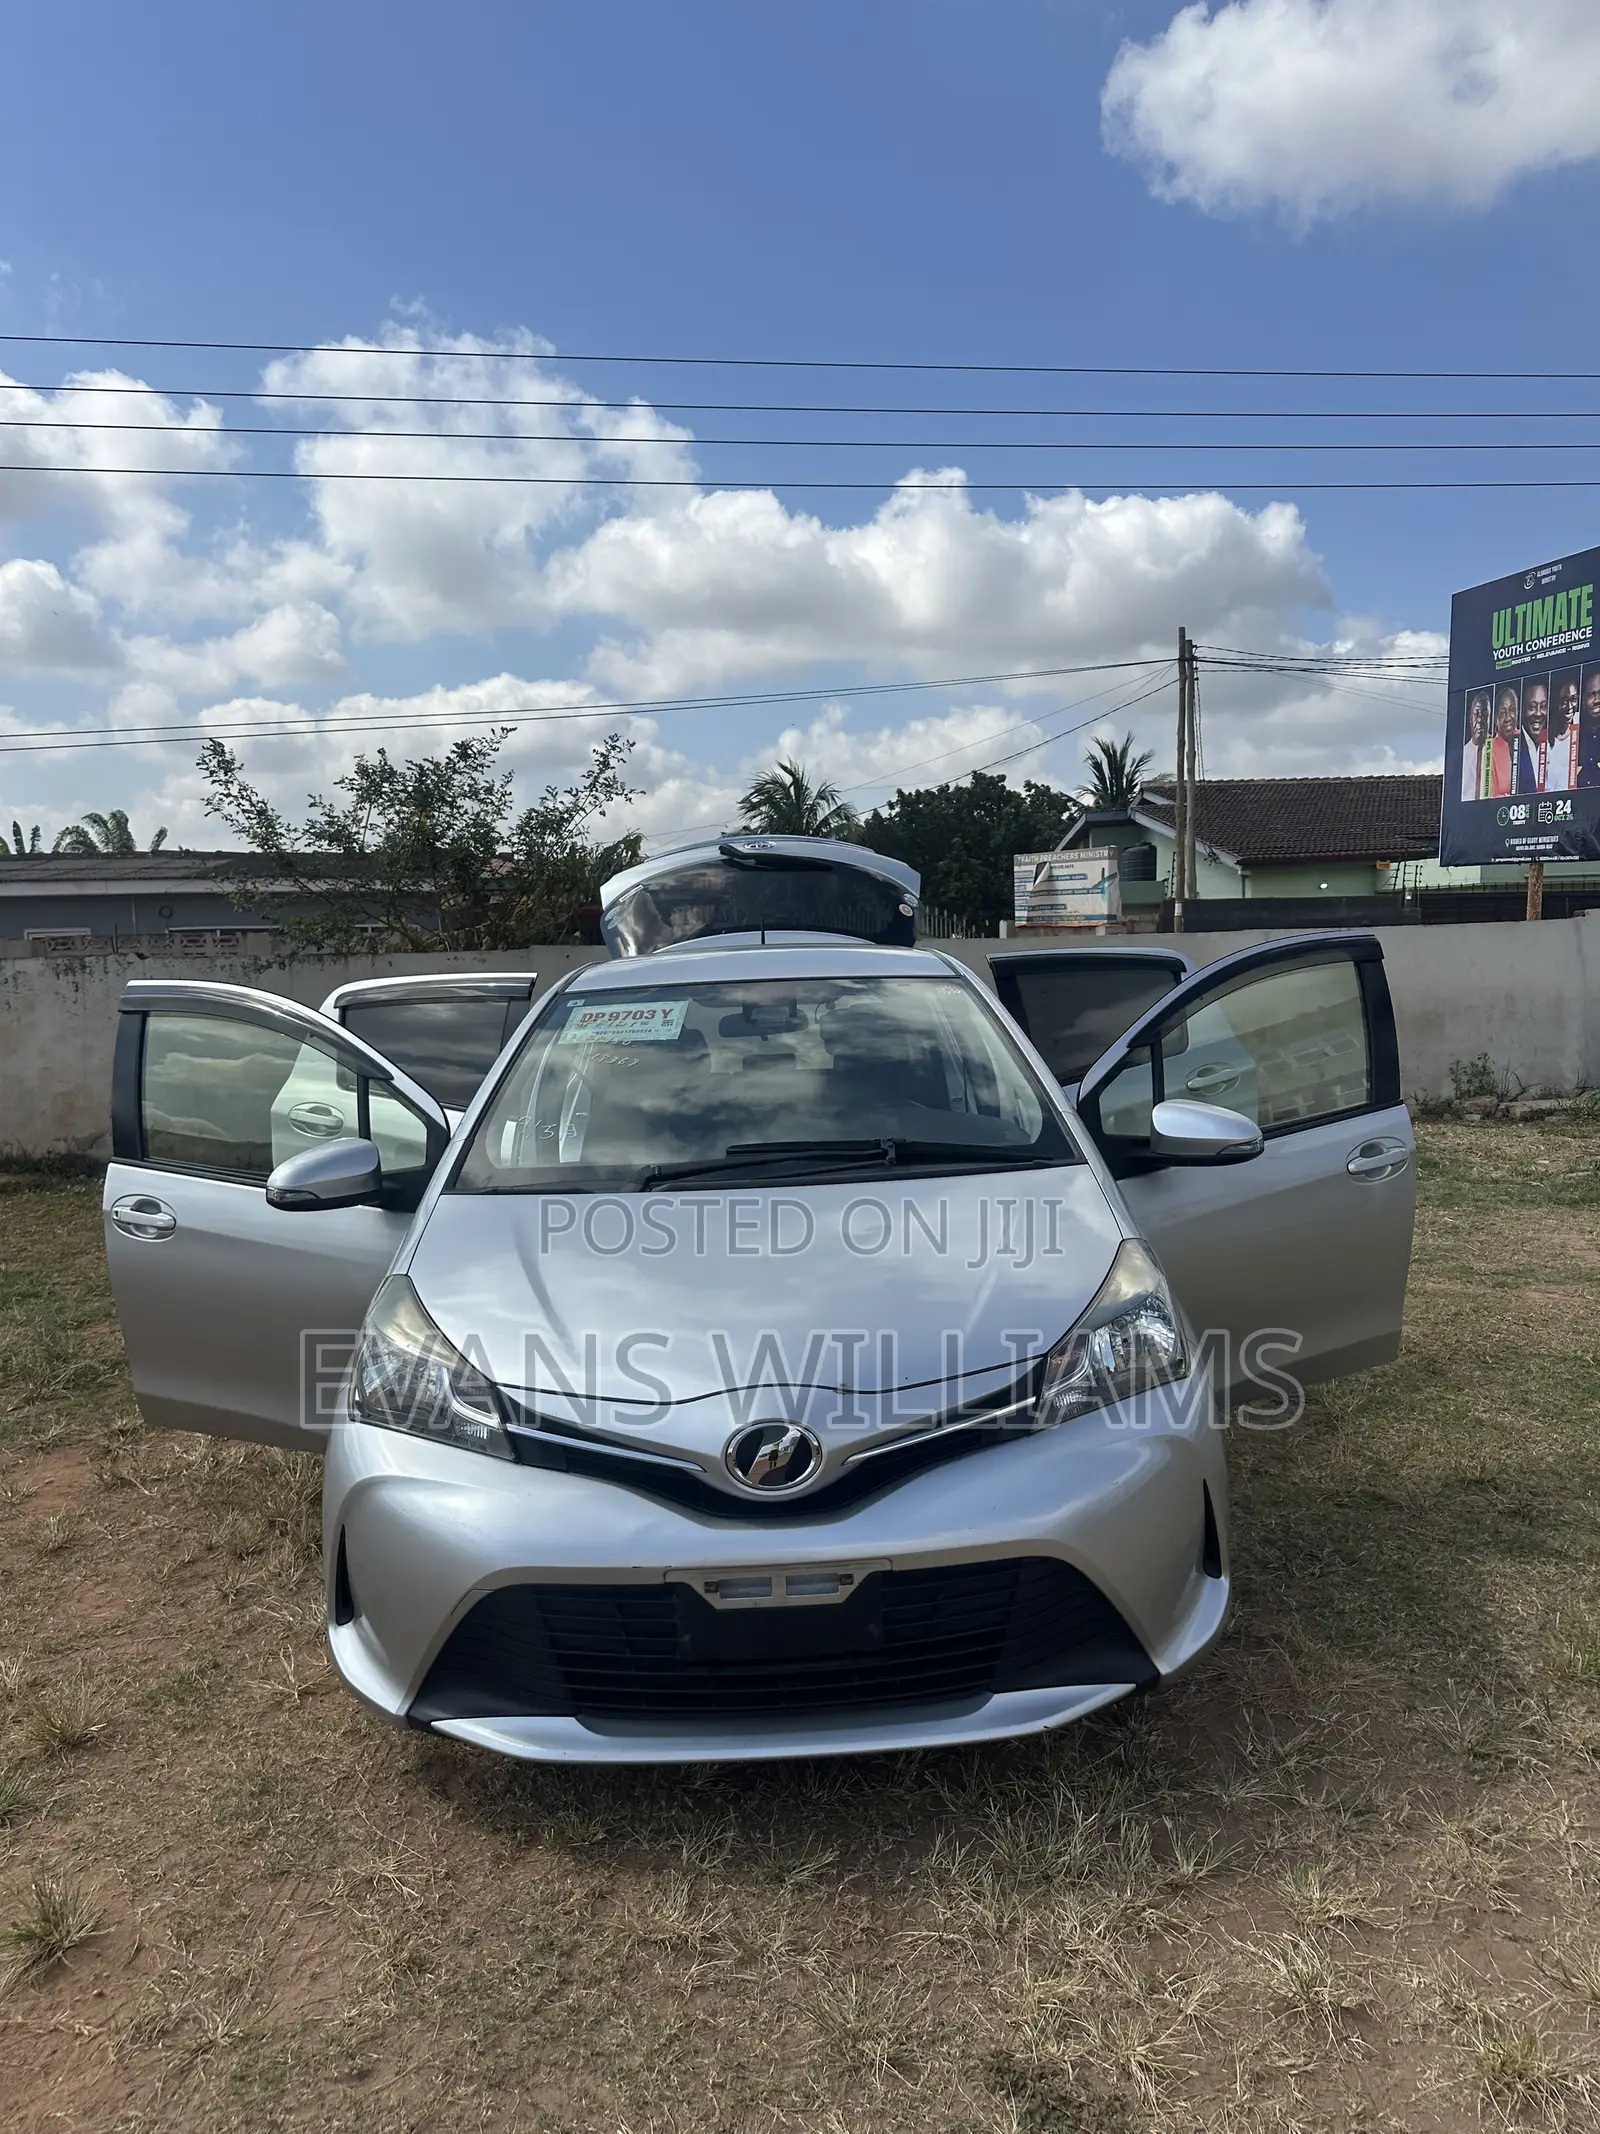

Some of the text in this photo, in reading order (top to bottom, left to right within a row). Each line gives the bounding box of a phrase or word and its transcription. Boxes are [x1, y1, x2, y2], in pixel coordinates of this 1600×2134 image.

[1492, 584, 1593, 649] ULTIMATE
[1493, 626, 1593, 660] YOUTH CONFERENCE
[1512, 655, 1531, 666] ROOTED
[1536, 647, 1567, 660] RELEVANCE
[1571, 642, 1590, 652] RISING
[1509, 804, 1526, 820] 08
[1556, 799, 1572, 815] 24
[1040, 851, 1079, 862] PREACHERS
[1080, 850, 1114, 859] MINISTRY
[607, 1009, 657, 1021] 9703
[661, 1008, 674, 1019] Y
